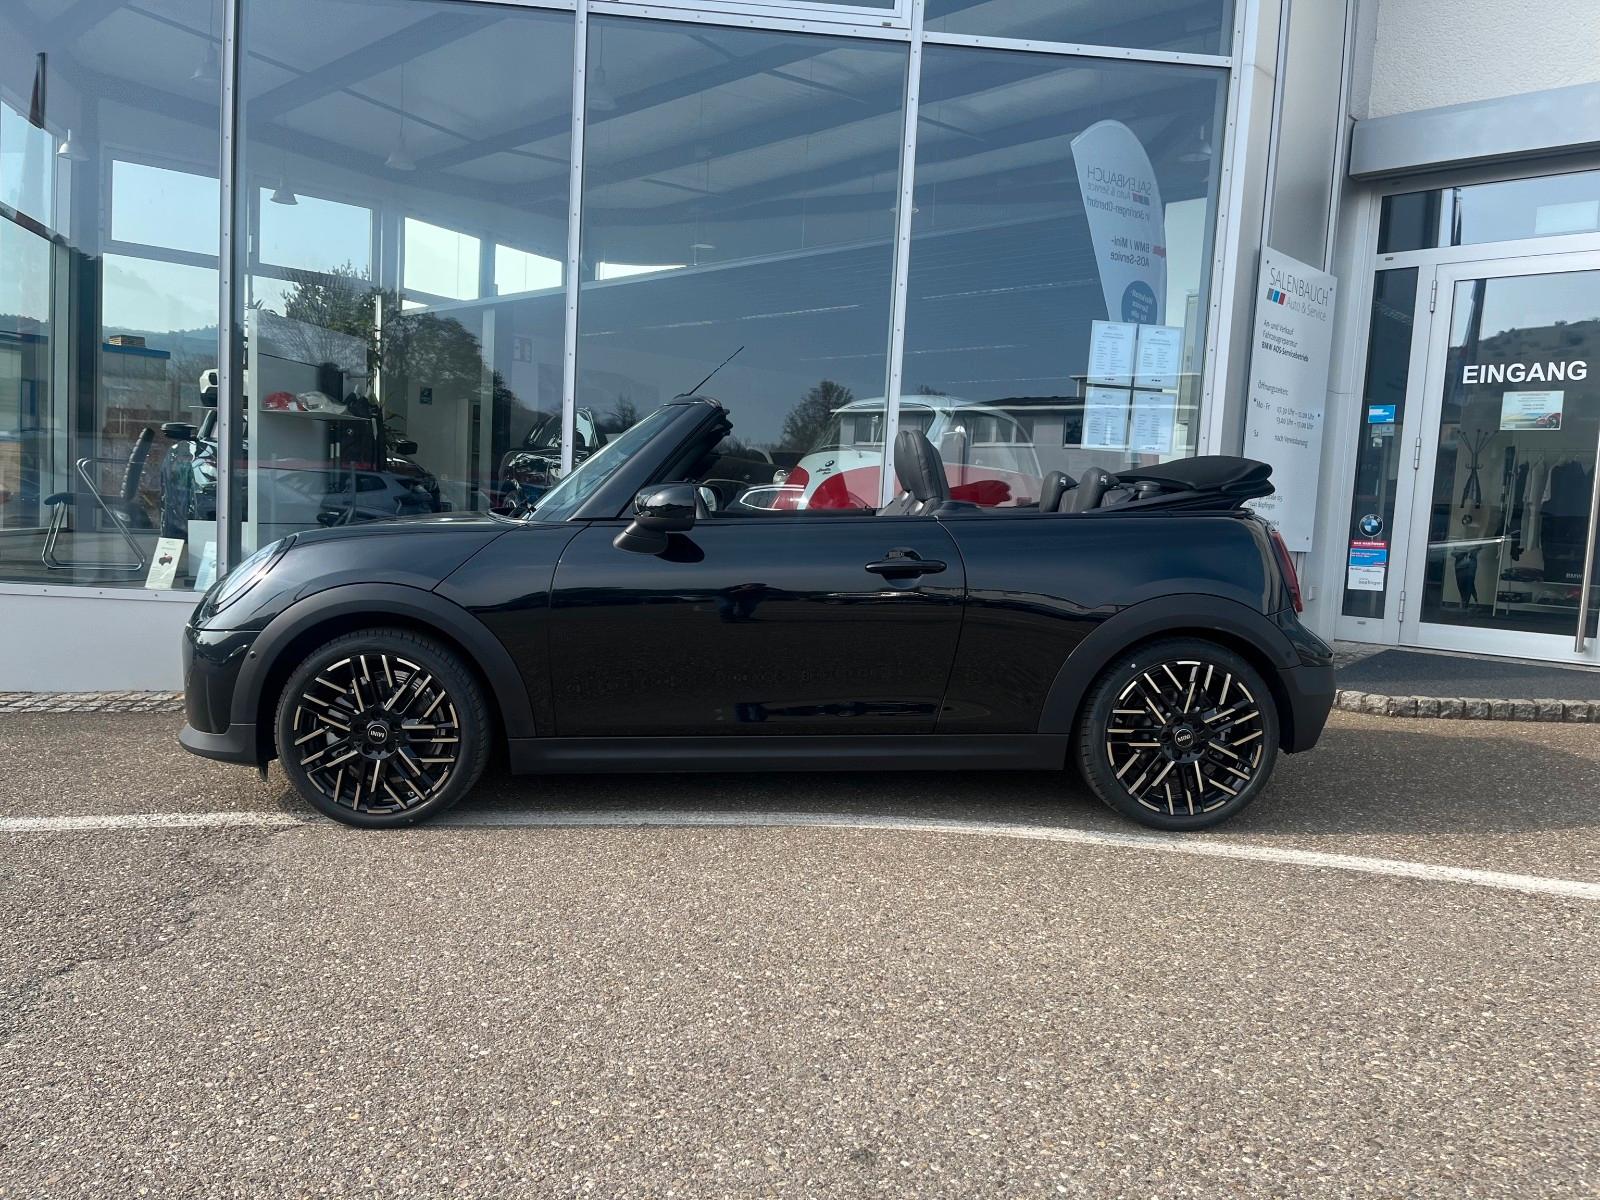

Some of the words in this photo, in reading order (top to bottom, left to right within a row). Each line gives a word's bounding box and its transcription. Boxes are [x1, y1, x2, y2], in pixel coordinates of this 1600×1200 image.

[1269, 267, 1329, 307] SALENBAUCH
[1286, 297, 1300, 312] Auto
[1306, 304, 1327, 321] Service
[1261, 341, 1273, 351] BMW
[1462, 360, 1588, 385] EINGANG
[1256, 400, 1263, 409] Mo
